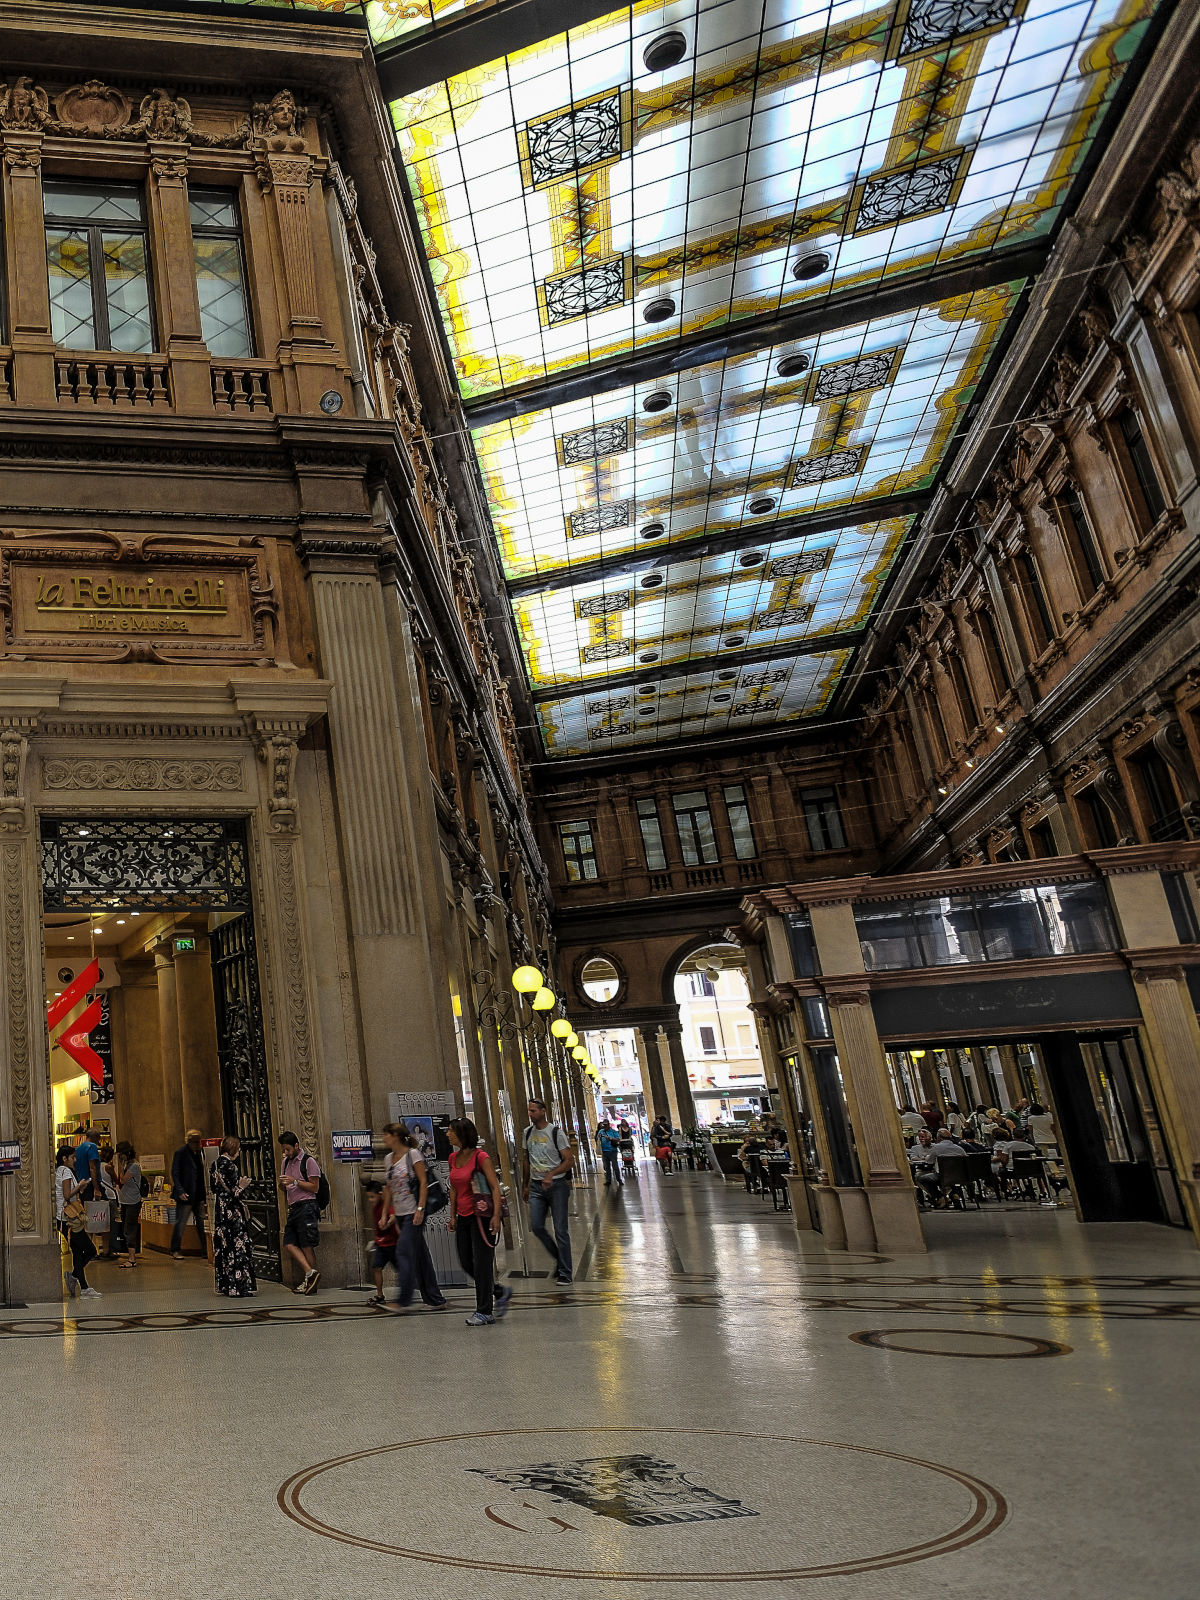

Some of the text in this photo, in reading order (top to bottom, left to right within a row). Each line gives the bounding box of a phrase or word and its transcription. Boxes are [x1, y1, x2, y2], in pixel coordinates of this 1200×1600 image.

[35, 575, 228, 608] la Feltrinelli
[78, 615, 118, 631] Libri
[131, 616, 189, 633] Musica
